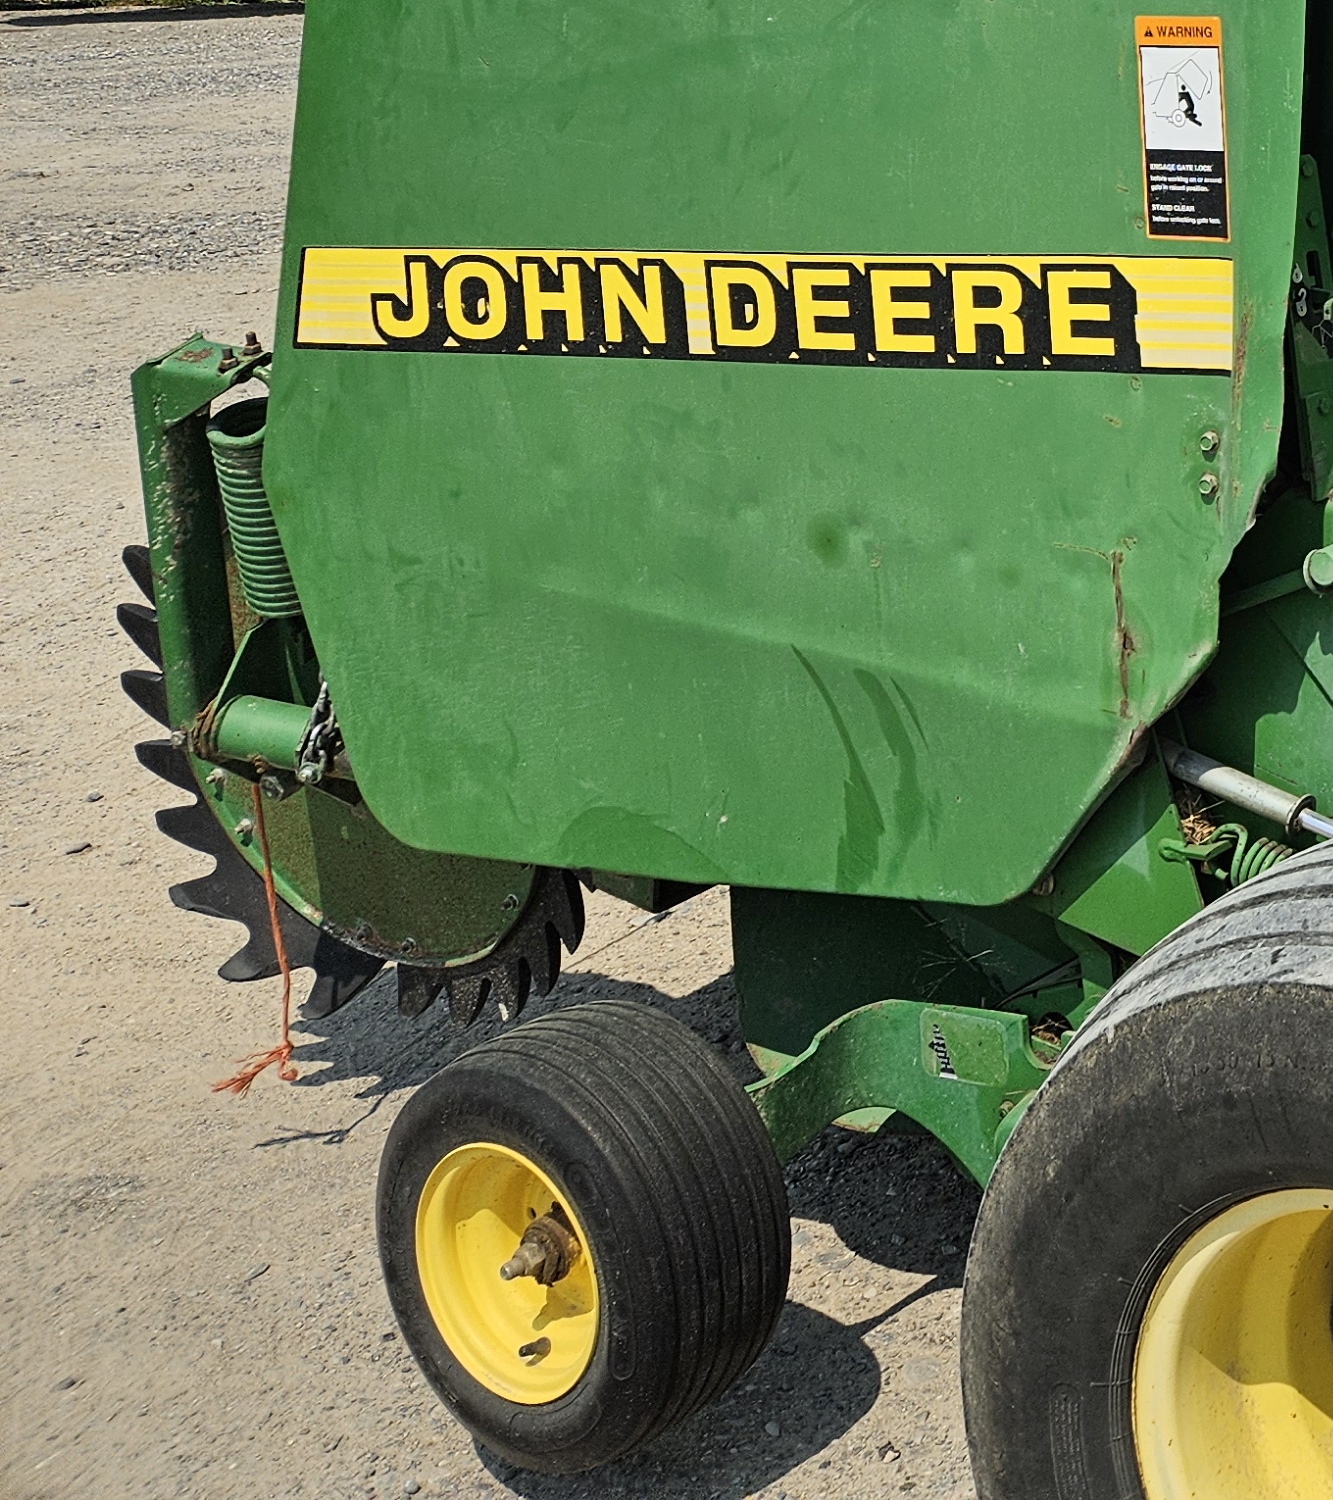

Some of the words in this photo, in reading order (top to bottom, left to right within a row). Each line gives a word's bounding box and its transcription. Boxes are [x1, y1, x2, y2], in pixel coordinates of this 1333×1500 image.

[1156, 26, 1213, 38] WARNING
[1176, 164, 1194, 172] GATE
[1194, 164, 1213, 172] LOCK
[1151, 204, 1173, 212] STAND
[370, 255, 676, 348] JOHN
[707, 260, 1125, 366] DEERE
